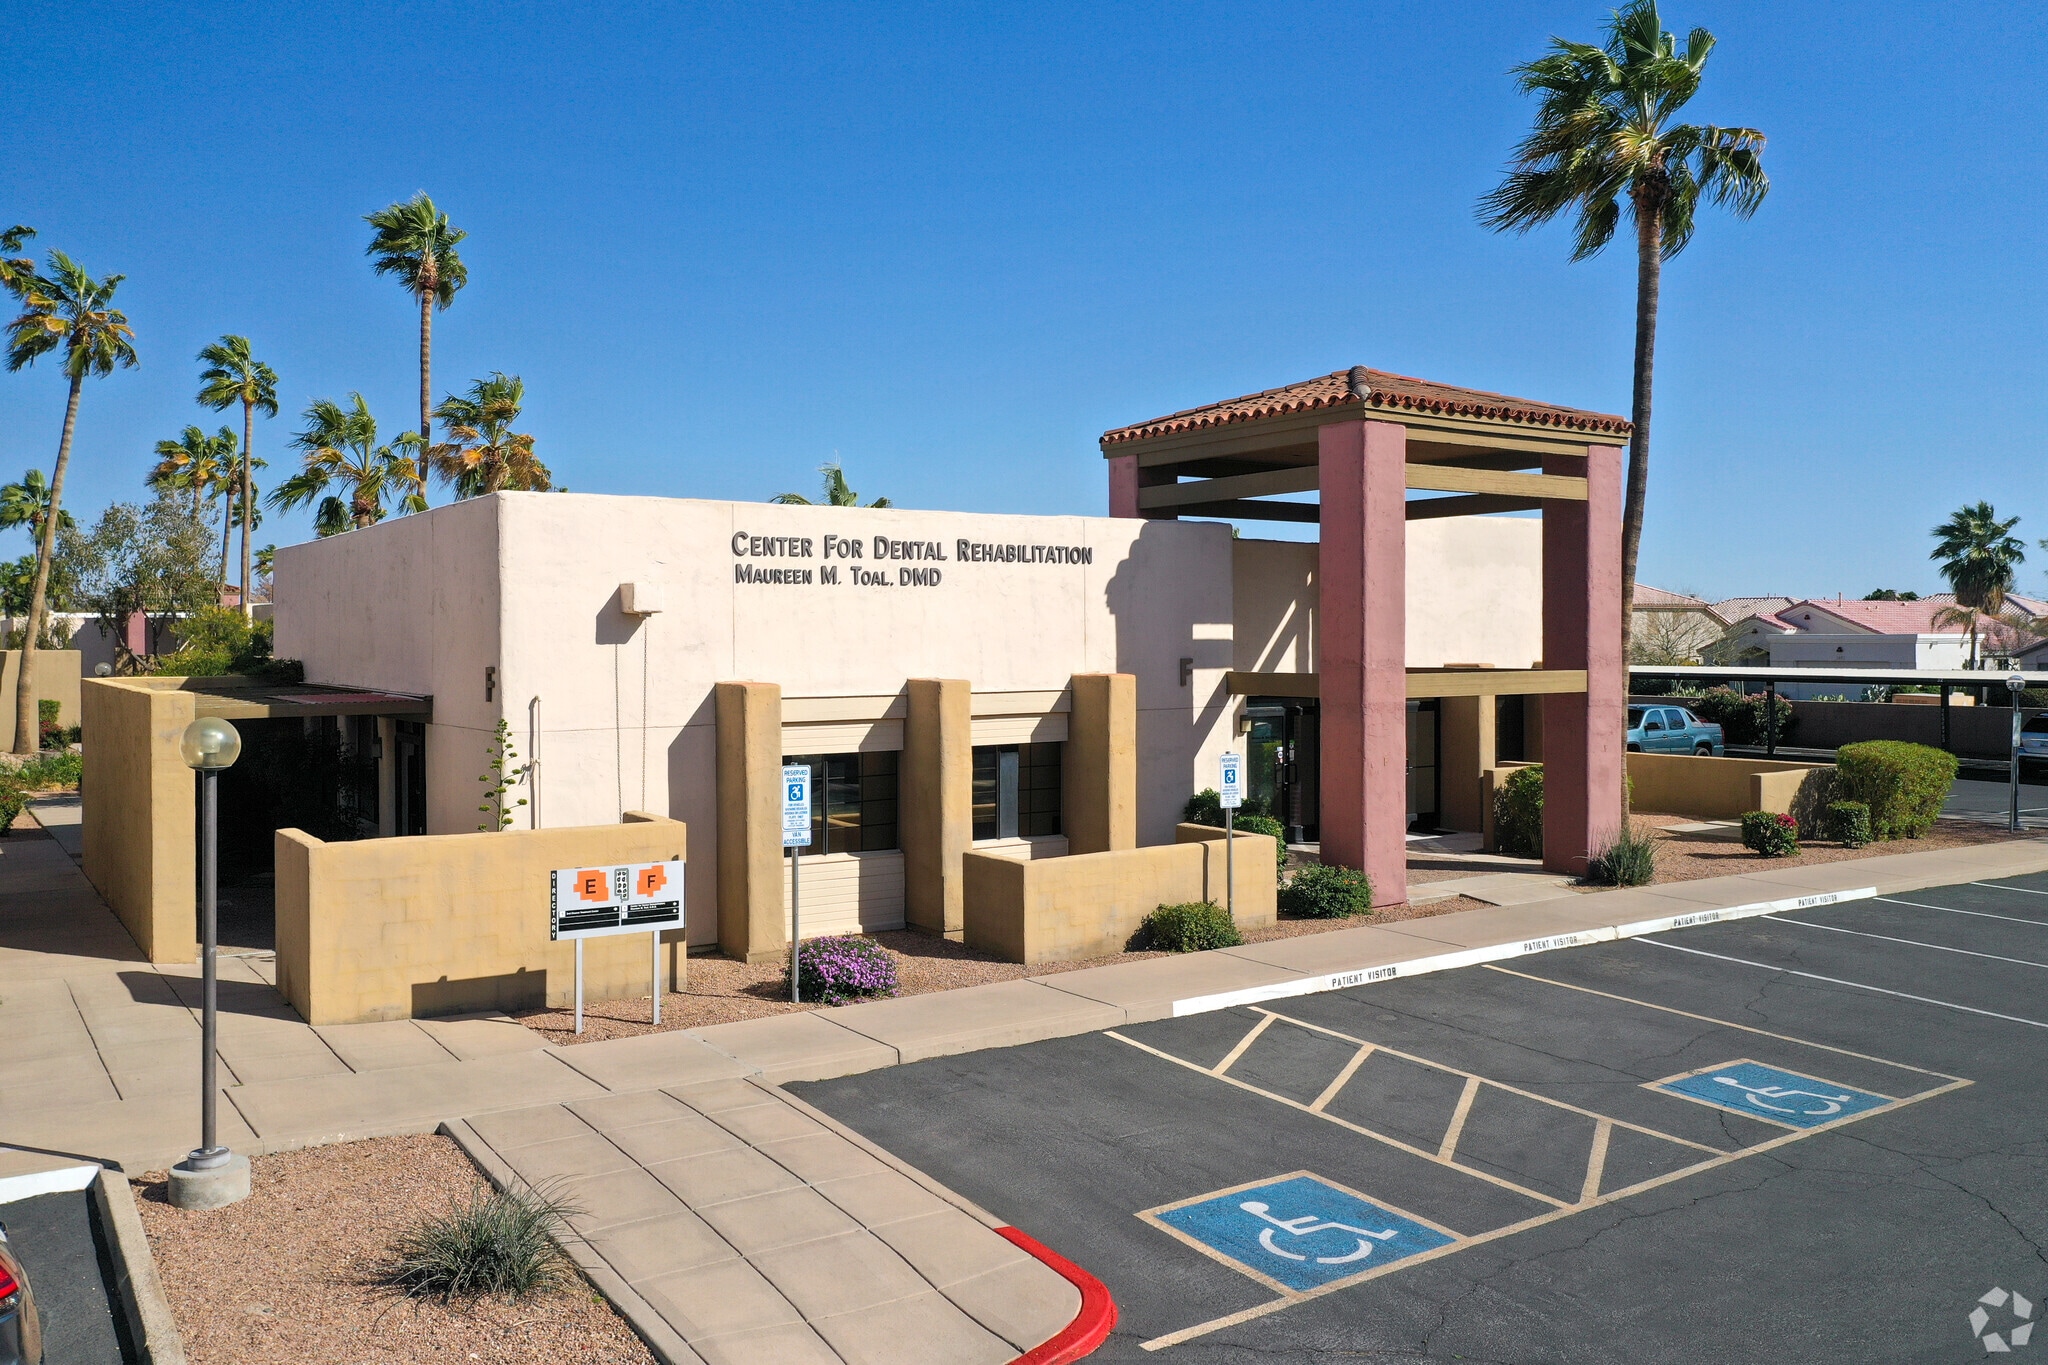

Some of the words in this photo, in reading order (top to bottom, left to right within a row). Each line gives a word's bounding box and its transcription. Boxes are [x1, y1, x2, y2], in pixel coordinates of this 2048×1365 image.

[731, 531, 813, 557] CENTER
[824, 535, 863, 559] FOR
[874, 536, 948, 561] DENTAL
[957, 539, 1093, 564] REHABILITATION
[735, 564, 812, 585] MAUREEN
[900, 567, 942, 587] DMD
[1180, 658, 1193, 687] F
[586, 879, 596, 894] E
[648, 875, 656, 888] F
[1523, 940, 1550, 951] PATIENT
[1553, 936, 1577, 946] VISITOR
[1332, 973, 1363, 987] PATIENT
[1367, 967, 1397, 980] VISITOR
